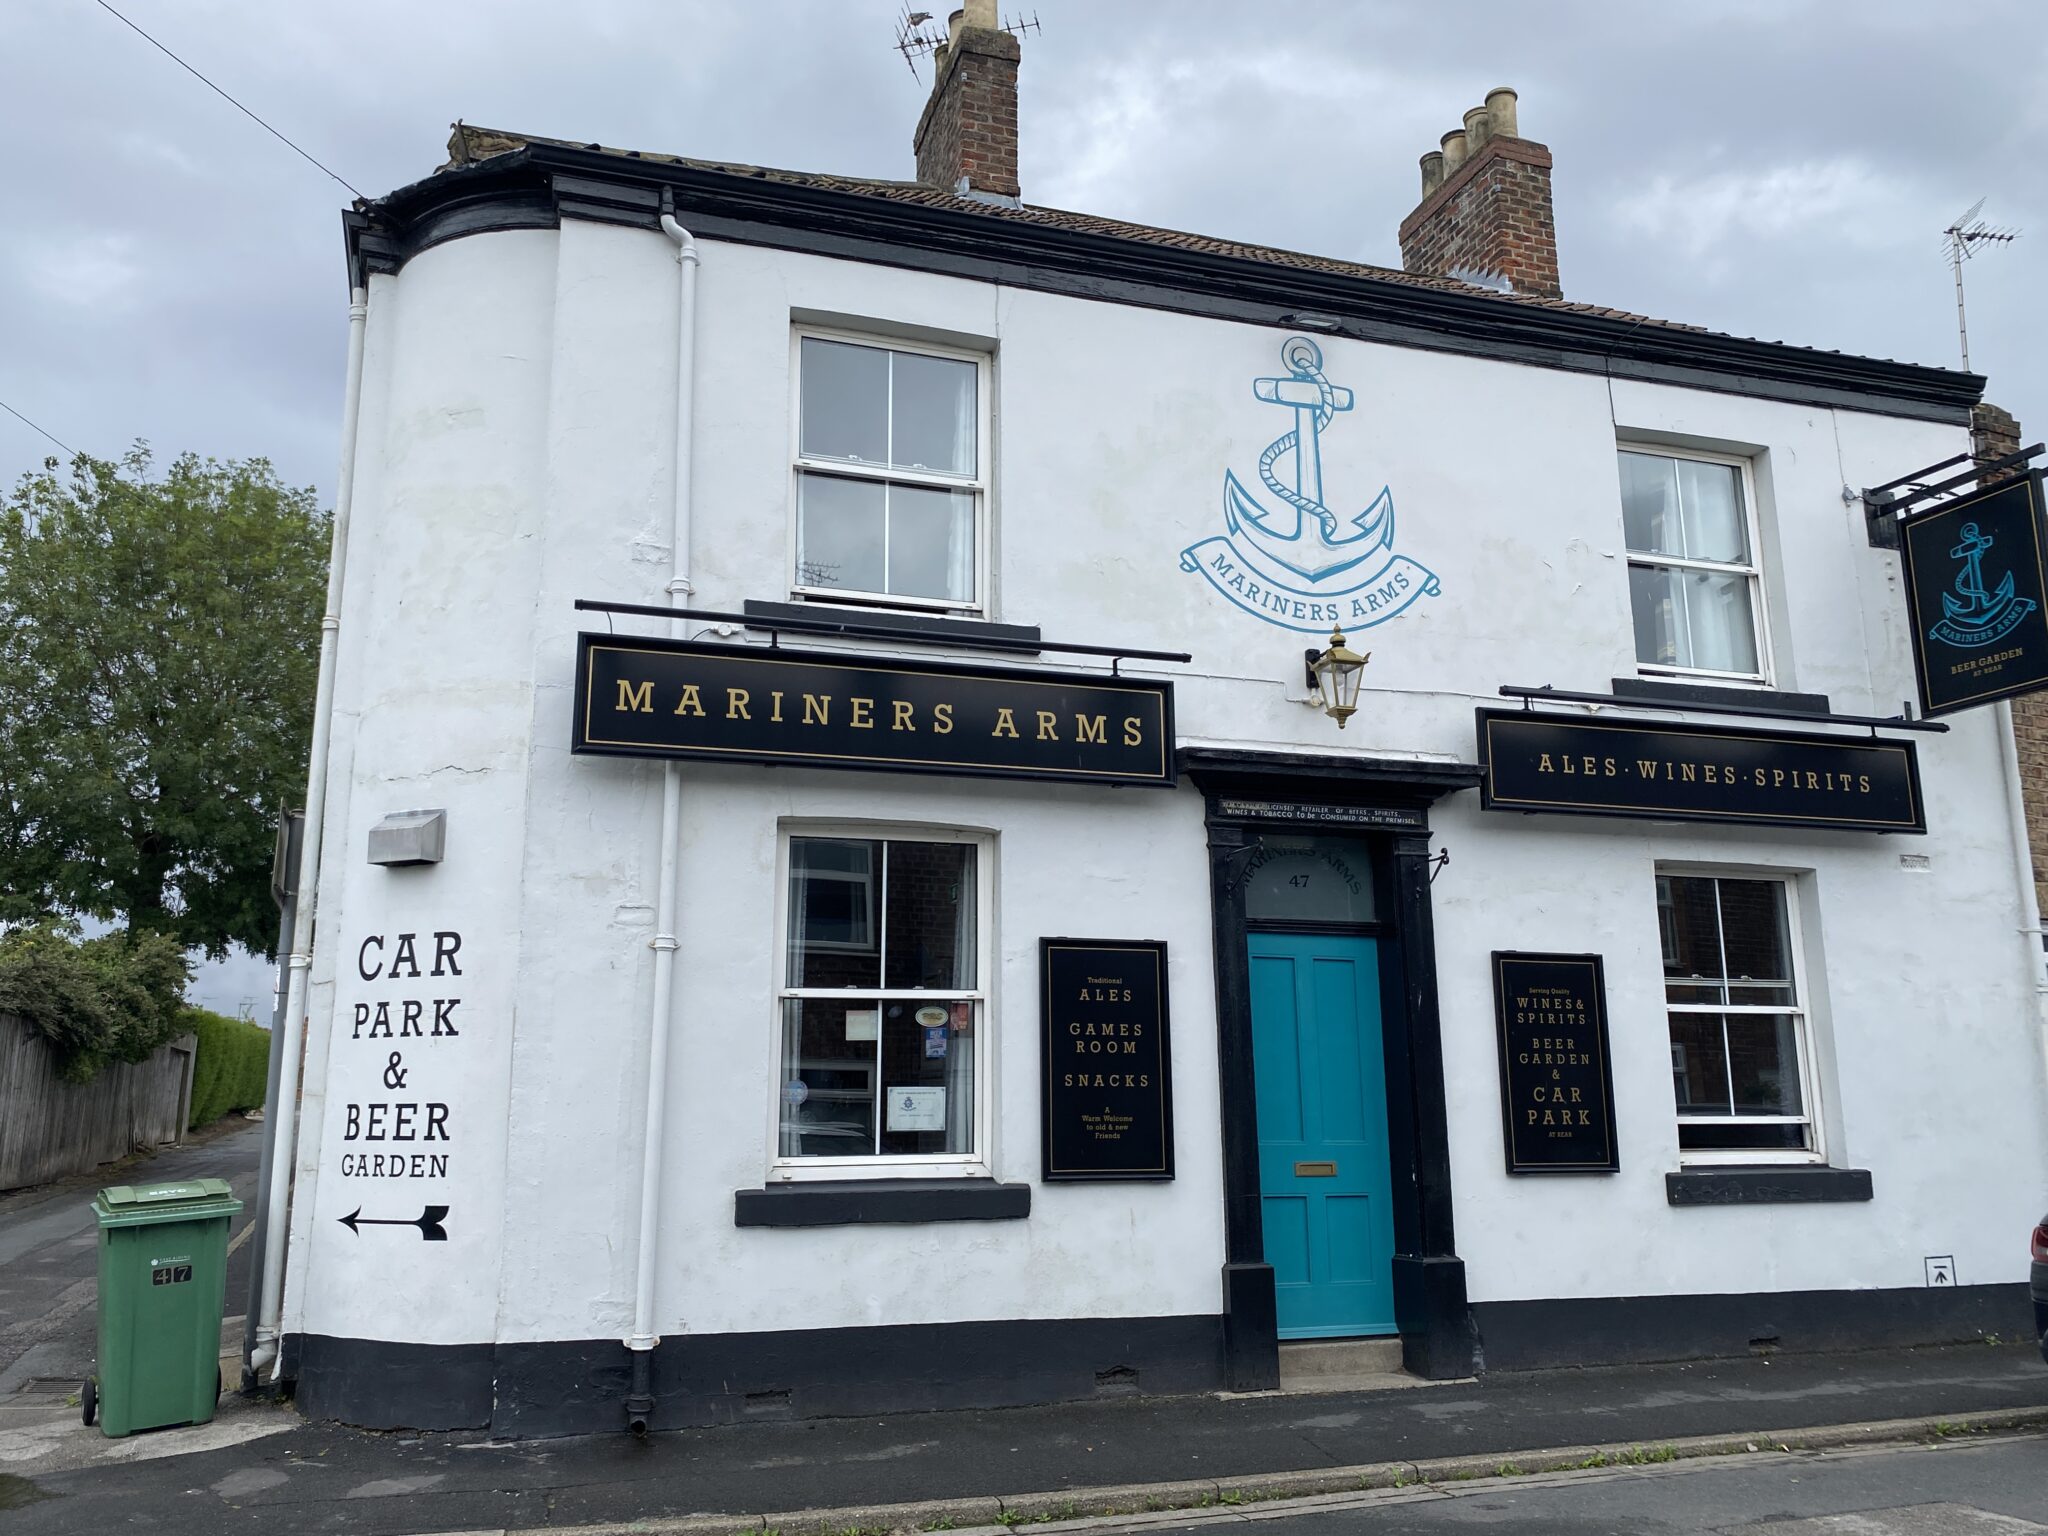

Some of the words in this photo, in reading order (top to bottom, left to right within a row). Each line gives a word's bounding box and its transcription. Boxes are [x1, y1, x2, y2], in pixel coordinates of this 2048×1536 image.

[1211, 554, 1339, 621] MARINERS
[1352, 572, 1410, 617] ARMS
[1941, 626, 1994, 642] MARINERS
[1997, 606, 2023, 632] ARMS
[1951, 661, 1977, 675] BEER
[1979, 647, 2023, 666] GARDEN
[615, 679, 954, 734] MARINERS
[992, 708, 1143, 747] ARMS
[1538, 754, 1616, 777] ALES
[1637, 761, 1735, 784] WINES
[1755, 769, 1870, 793] SPIRITS
[1226, 808, 1248, 816] WINES
[1259, 810, 1293, 818] TOBACCO
[1296, 811, 1305, 819] to
[1320, 813, 1356, 821] CONSUMED
[1371, 815, 1382, 823] THE
[1289, 875, 1309, 888] 47
[358, 931, 463, 981] CAR
[1088, 977, 1123, 985] Traditional
[1079, 989, 1132, 1001] ALES
[352, 999, 461, 1039] PARK
[1517, 1013, 1586, 1025] SPIRITS
[1069, 1023, 1142, 1036] GAMES
[1076, 1041, 1137, 1054] ROOM
[1533, 1038, 1574, 1049] BEER
[1519, 1053, 1590, 1065] GARDEN
[383, 1051, 408, 1090] &
[1552, 1069, 1560, 1080] &
[1065, 1074, 1149, 1087] SNACKS
[1533, 1087, 1582, 1102] CAR
[344, 1103, 450, 1141] BEER
[1527, 1109, 1590, 1125] PARK
[341, 1154, 449, 1178] GARDEN
[155, 1266, 190, 1284] 47
